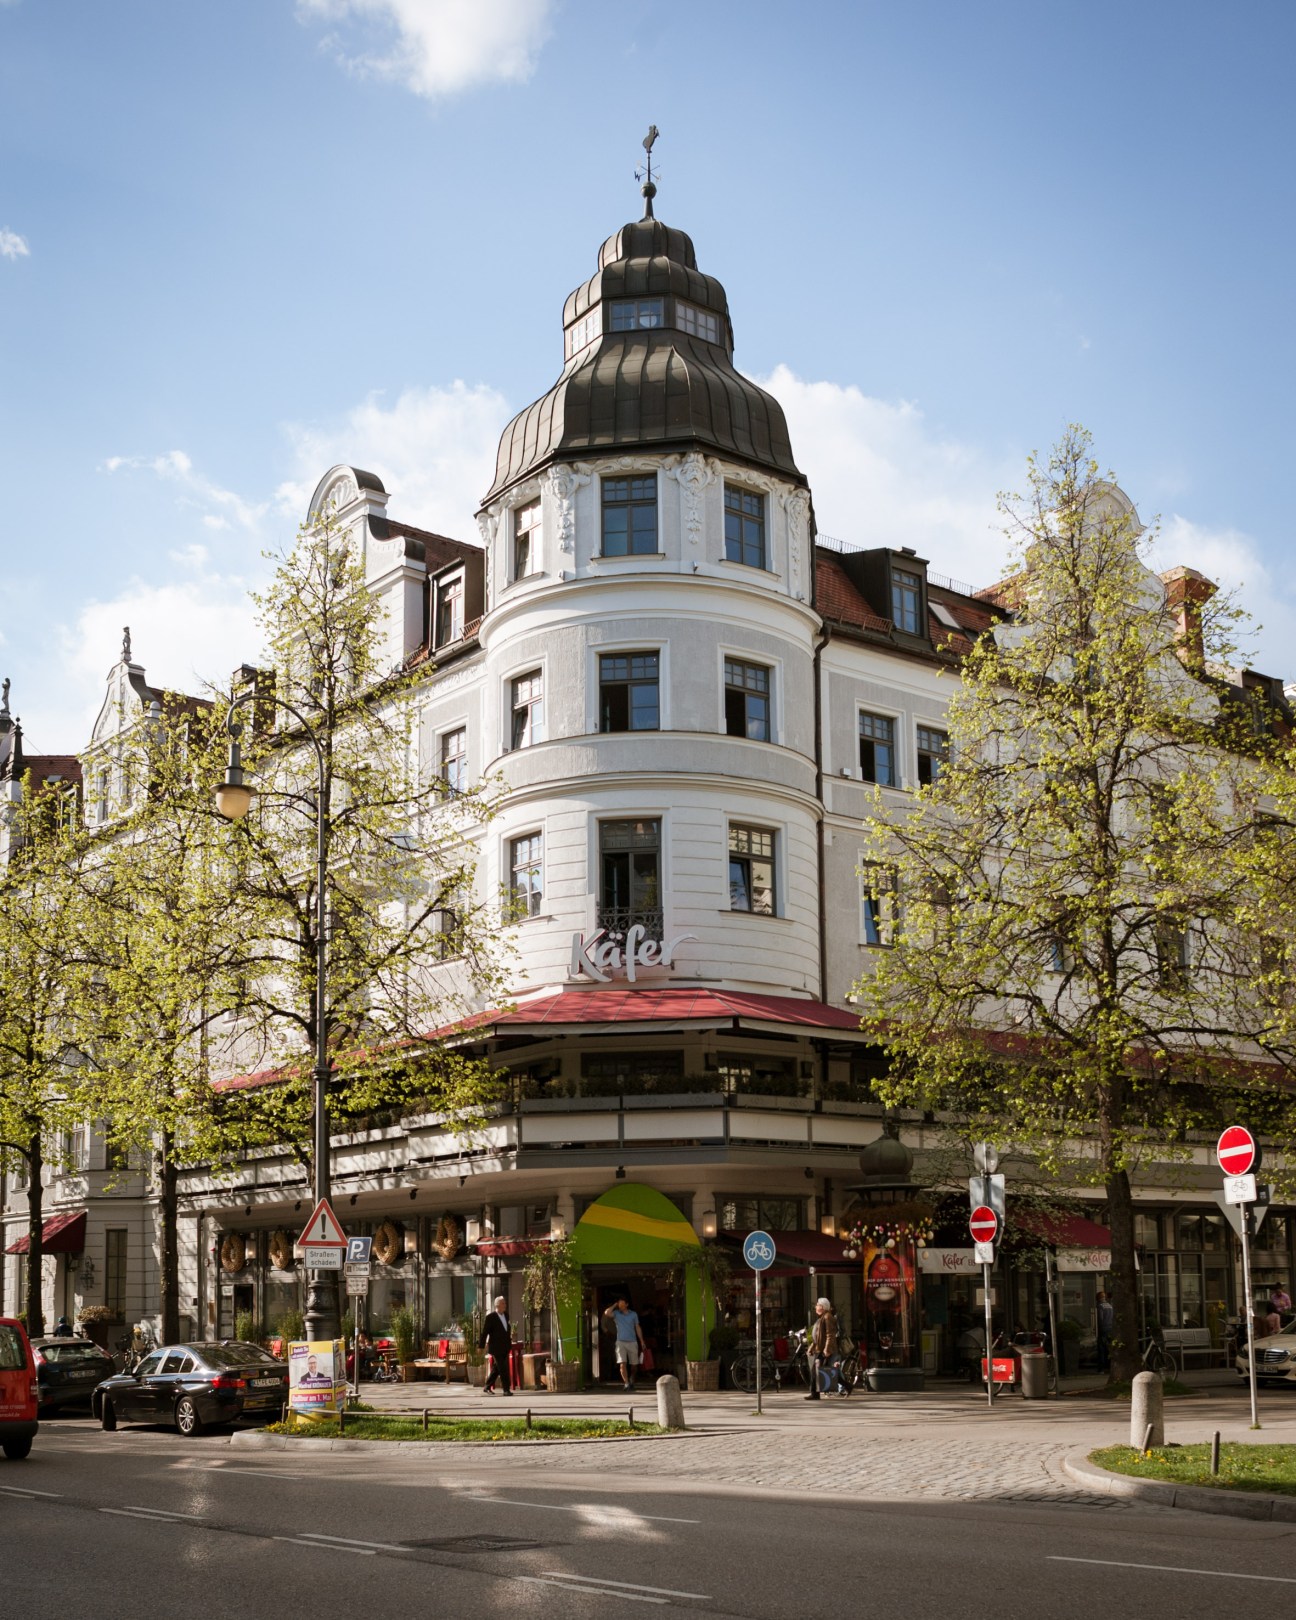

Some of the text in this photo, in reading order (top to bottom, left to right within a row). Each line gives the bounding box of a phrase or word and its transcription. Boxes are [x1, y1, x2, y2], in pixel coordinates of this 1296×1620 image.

[571, 924, 699, 982] Käfer
[310, 1250, 337, 1258] Straßen-
[350, 1241, 364, 1259] P
[942, 1252, 968, 1270] Käfer
